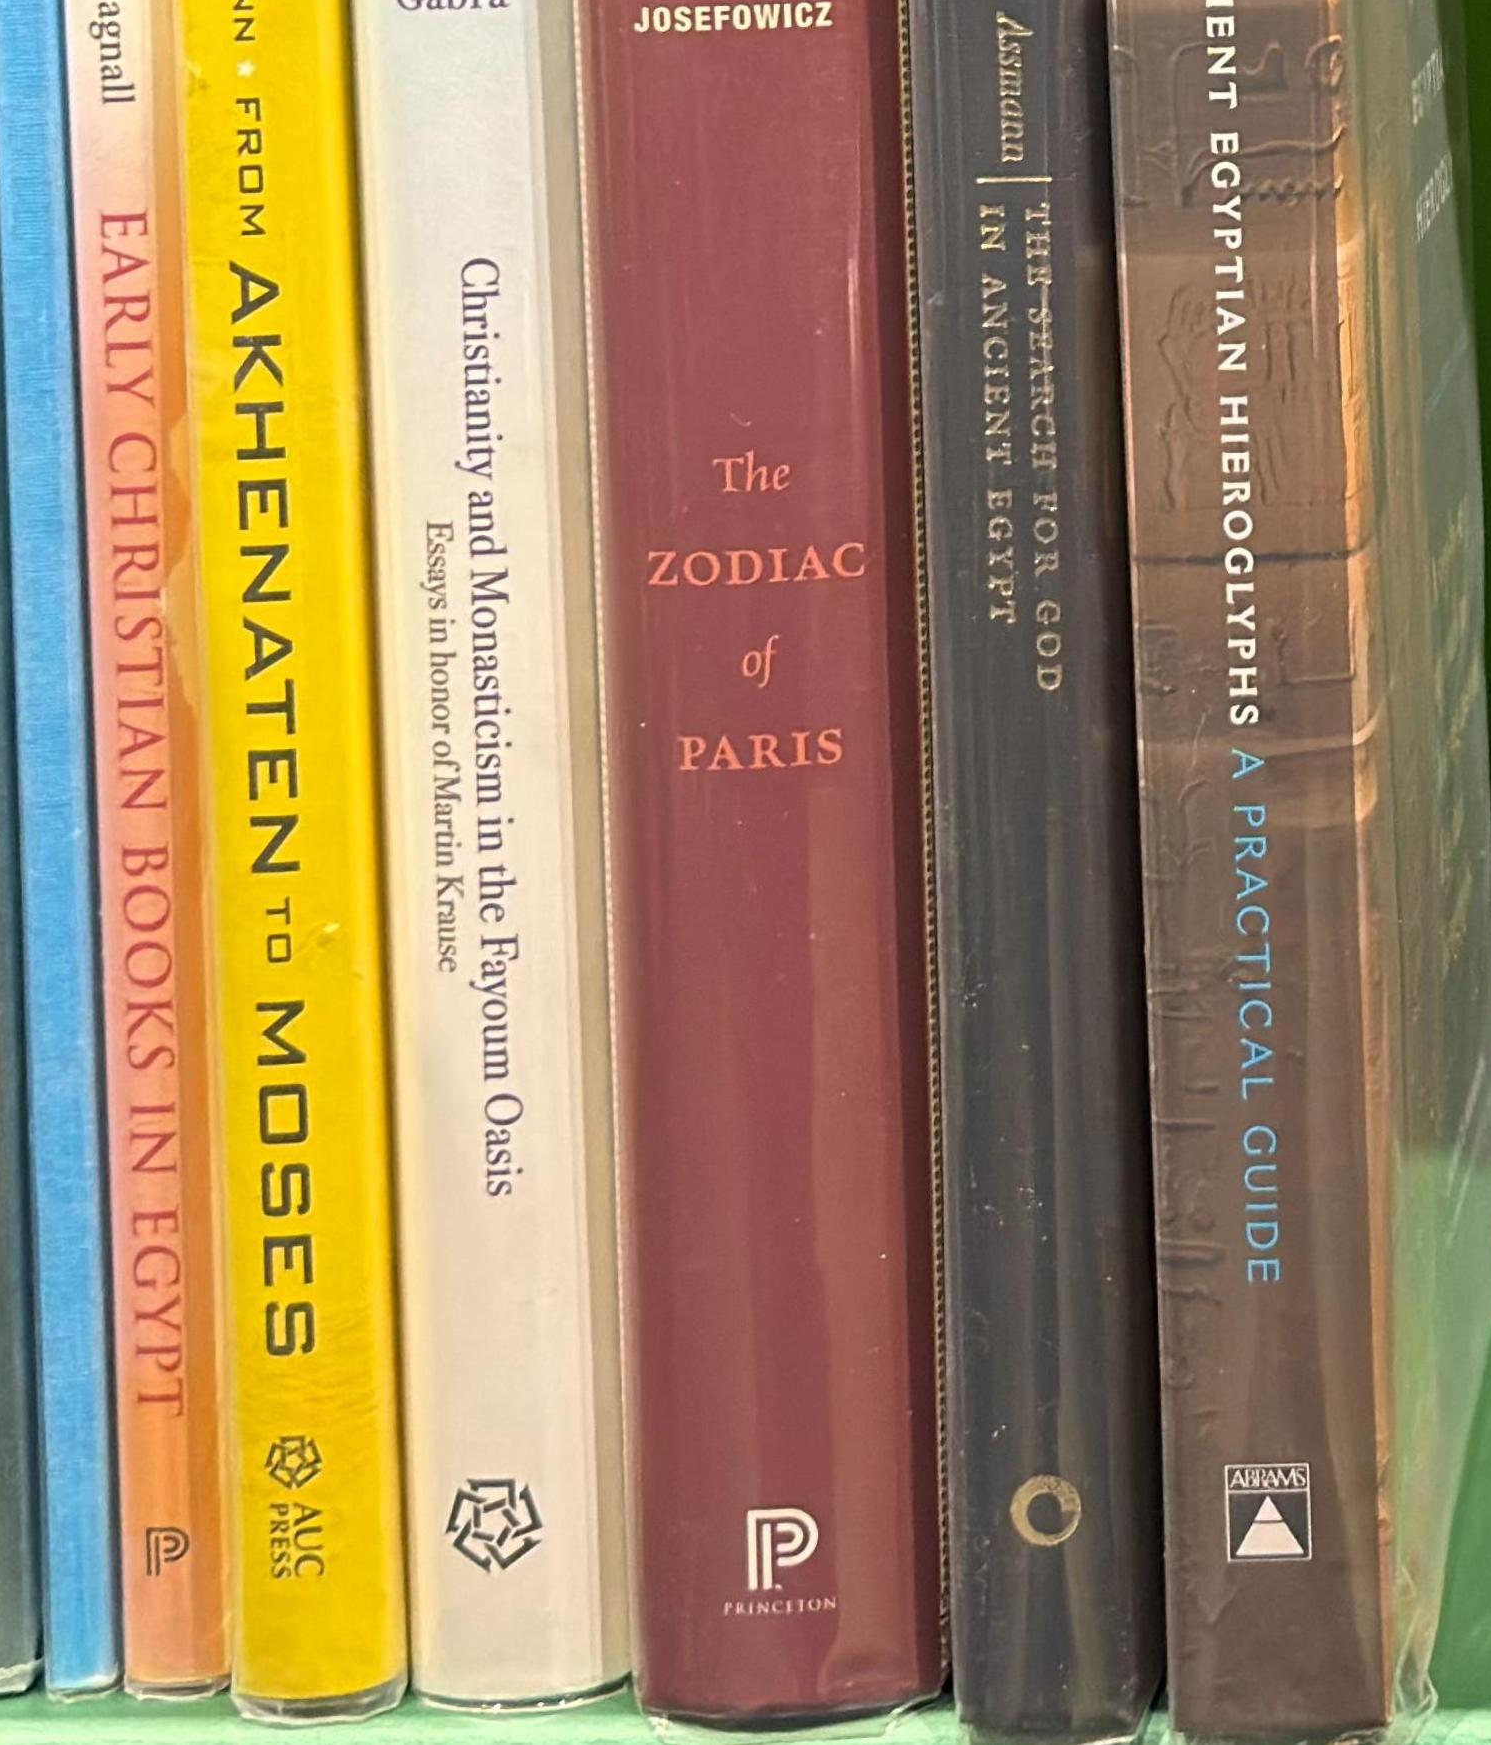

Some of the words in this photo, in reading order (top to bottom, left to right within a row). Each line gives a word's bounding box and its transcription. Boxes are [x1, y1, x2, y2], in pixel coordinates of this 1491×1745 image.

[634, 1, 834, 33] JOSEFOWICZ
[996, 11, 1034, 162] Assmann
[234, 96, 266, 238] FROM
[979, 203, 1007, 251] IN
[1024, 202, 1052, 286] THE
[1209, 131, 1252, 373] EGYPTIAN
[98, 209, 157, 407] EARLY
[455, 255, 503, 481] Christianity
[981, 272, 1013, 466] ANCIENT
[1028, 308, 1058, 470] SEARCH
[713, 449, 791, 494] The
[229, 260, 301, 875] AKHENATEN
[420, 519, 453, 610] Essays
[467, 490, 508, 560] and
[647, 542, 867, 587] ZODIAC
[987, 488, 1017, 624] EGYPT
[1032, 491, 1060, 577] FOR
[1217, 395, 1259, 727] HIEROGLYPHS
[109, 430, 169, 812] CHRISTIAN
[428, 615, 457, 644] in
[741, 634, 780, 686] of
[1036, 599, 1063, 691] GOD
[429, 650, 458, 735] honor
[470, 566, 512, 805] Monasticism
[431, 736, 460, 773] of
[680, 729, 845, 773] PARIS
[1231, 749, 1266, 781] A
[433, 772, 463, 868] Martin
[477, 812, 515, 854] in
[265, 897, 291, 964] TO
[435, 874, 465, 974] Krause
[477, 864, 518, 924] the
[117, 846, 176, 1072] BOOKS
[1234, 804, 1275, 1098] PRACTICAL
[468, 932, 520, 1083] Fayoum
[127, 1103, 180, 1176] IN
[255, 1000, 315, 1358] MOSES
[484, 1092, 525, 1198] Oasis
[1243, 1126, 1280, 1285] GUIDE
[127, 1206, 189, 1418] EGYPT
[1228, 1466, 1307, 1490] ABRAMS
[269, 1501, 292, 1581] PRESS
[292, 1501, 326, 1580] AUC
[722, 1594, 839, 1617] PRINCETON
